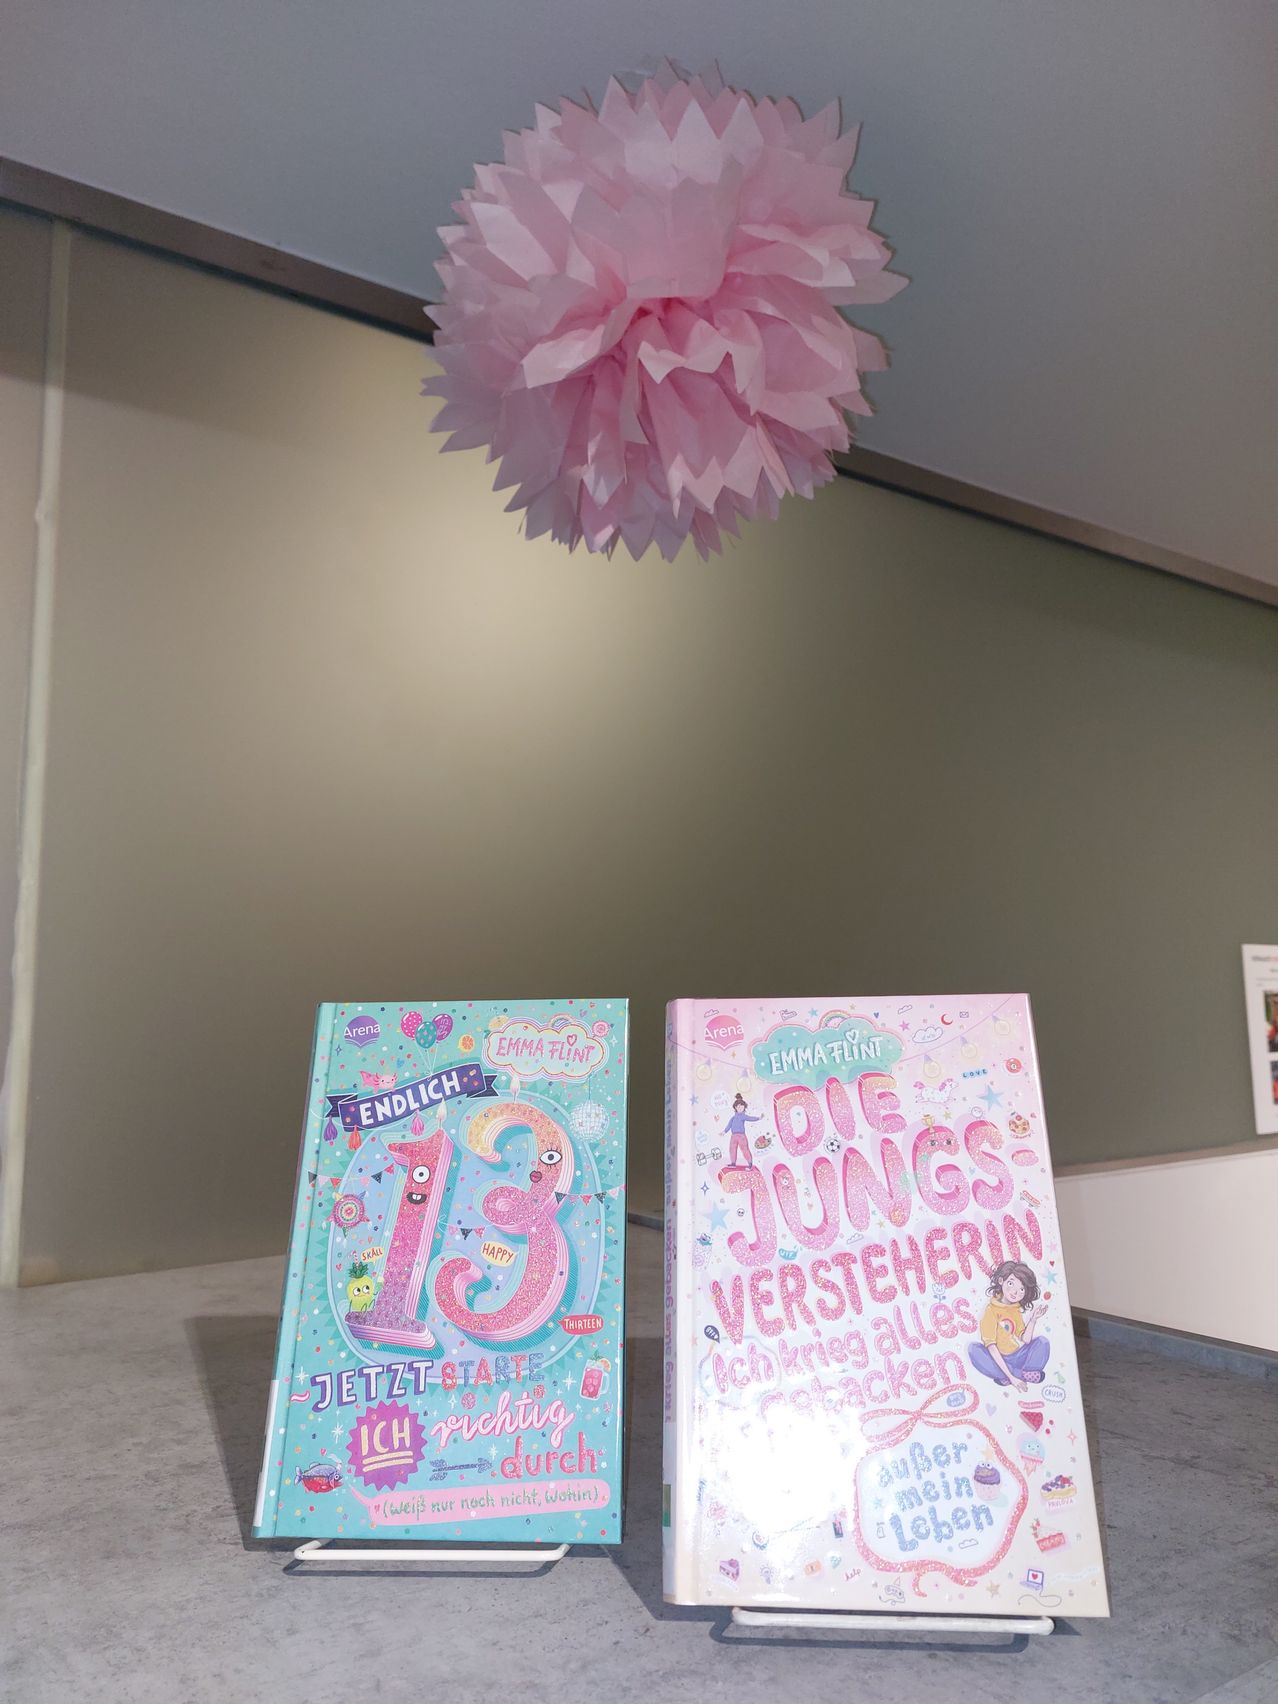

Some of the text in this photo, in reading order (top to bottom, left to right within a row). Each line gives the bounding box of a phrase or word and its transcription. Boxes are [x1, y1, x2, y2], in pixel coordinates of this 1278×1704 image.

[343, 1021, 381, 1038] Arena
[496, 1037, 545, 1057] EMMA
[704, 1024, 745, 1040] Arena
[769, 1043, 828, 1075] EMMA
[962, 1068, 988, 1079] LOVE
[358, 1071, 462, 1127] ENDLICH
[773, 1072, 907, 1157] DIE
[481, 1243, 514, 1263] HAPPY
[709, 1208, 1043, 1345] VERSTEHERIN
[563, 1317, 603, 1331] THIRTEEN
[713, 1297, 980, 1394] Ich krieg alles
[311, 1352, 545, 1413] JETZT STARTE
[1044, 1389, 1063, 1398] CRUSH
[360, 1390, 576, 1456] ICH richtig
[500, 1431, 598, 1479] durch
[879, 1441, 968, 1488] außer
[431, 1500, 456, 1512] nur
[460, 1489, 495, 1509] noch
[501, 1490, 542, 1507] nicht,
[895, 1471, 974, 1512] mein
[889, 1504, 994, 1552] Leben
[844, 1567, 862, 1582] help
